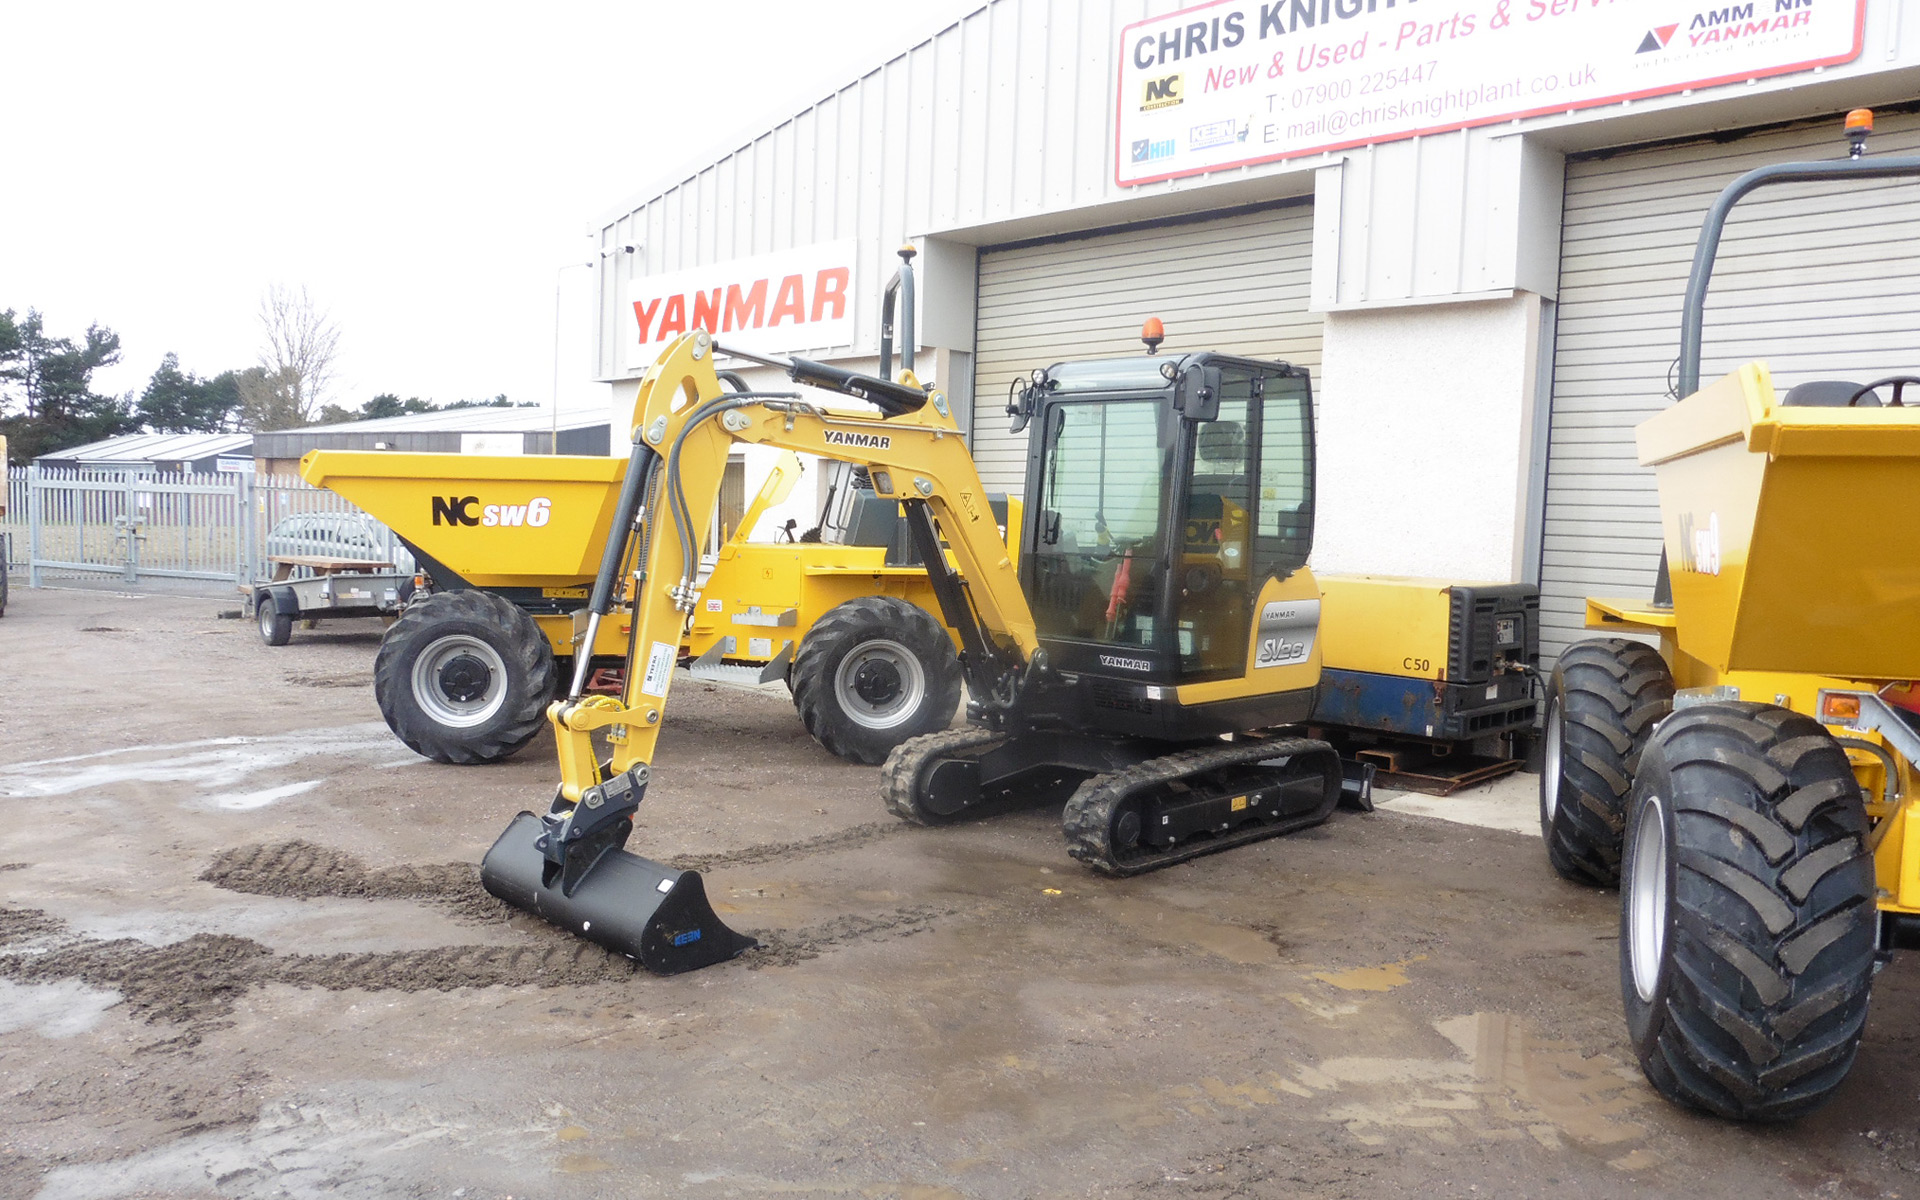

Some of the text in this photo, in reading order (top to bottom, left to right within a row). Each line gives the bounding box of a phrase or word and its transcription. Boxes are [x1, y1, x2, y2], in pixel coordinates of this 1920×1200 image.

[1133, 0, 1418, 70] CHRIS KNIG
[1688, 10, 1812, 48] YANMAR
[1203, 64, 1259, 94] New
[1267, 51, 1285, 79] &
[1296, 31, 1369, 73] Used
[1395, 11, 1477, 51] Parts
[1489, 0, 1511, 30] &
[1145, 75, 1179, 102] NC
[1291, 78, 1352, 109] 07900
[1359, 60, 1438, 95] 225447
[1263, 63, 1597, 143] E: mail@chrisknightplant.co.uk
[1150, 139, 1176, 160] Hill
[632, 266, 850, 344] YANMAR
[823, 430, 891, 450] YANMAR
[431, 496, 480, 527] NC
[1266, 611, 1295, 620] YANMAR
[1099, 655, 1150, 671] YANMAR
[1260, 638, 1304, 662] SV26
